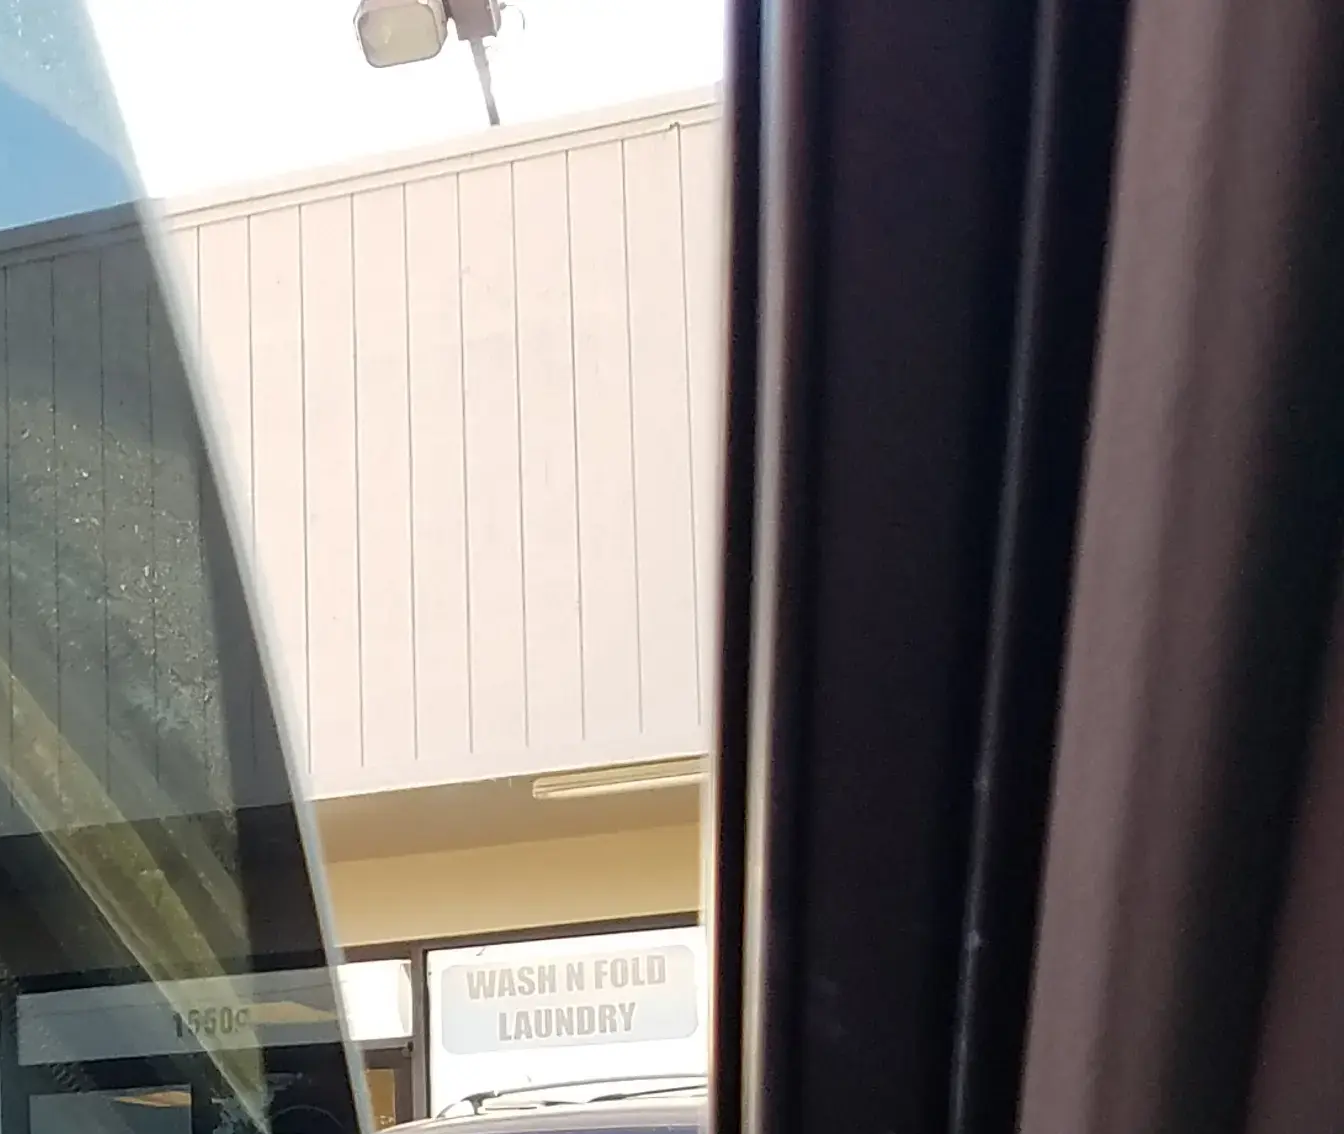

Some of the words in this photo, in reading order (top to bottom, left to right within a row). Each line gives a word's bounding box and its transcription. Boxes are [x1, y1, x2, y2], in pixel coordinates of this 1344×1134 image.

[466, 963, 557, 1001] WASH
[566, 961, 585, 993] N
[594, 955, 667, 990] FOLD
[498, 1001, 637, 1042] LAUNDRY
